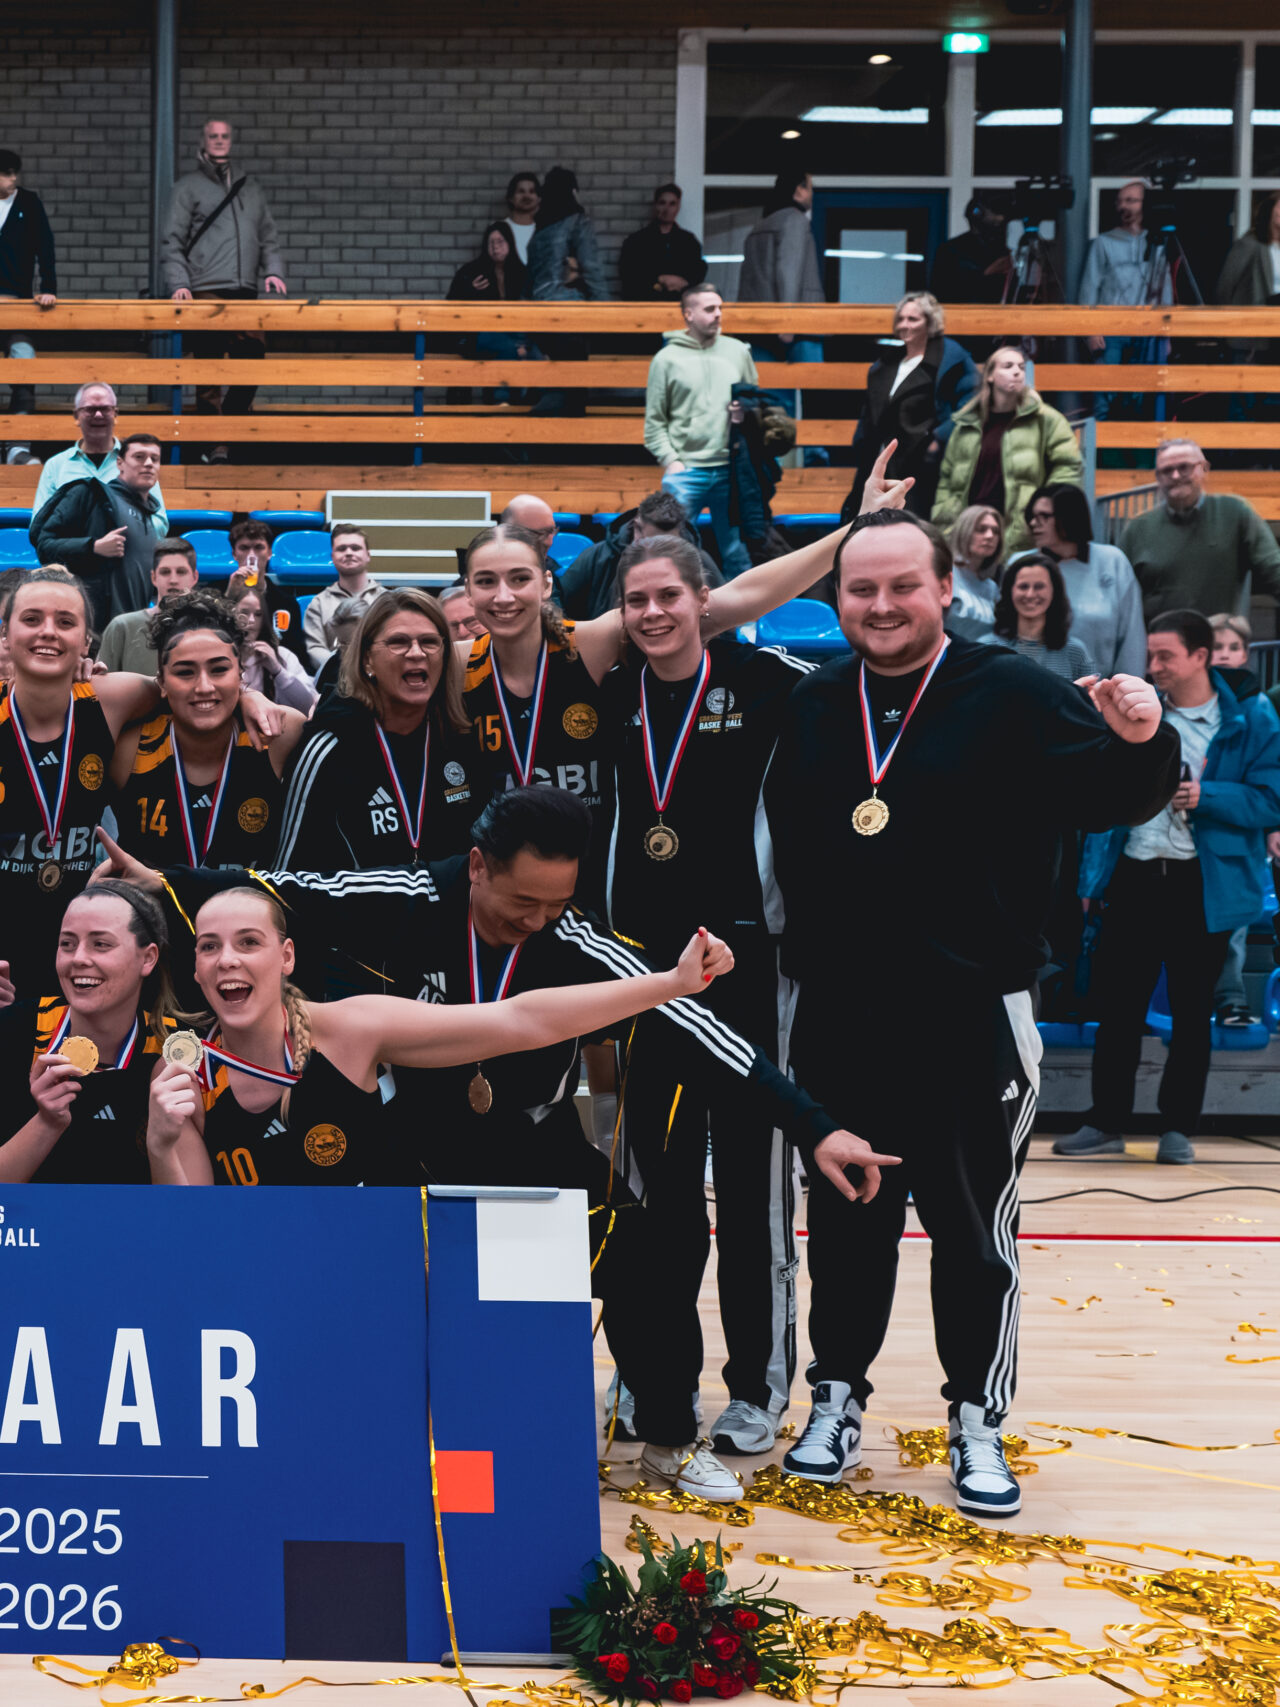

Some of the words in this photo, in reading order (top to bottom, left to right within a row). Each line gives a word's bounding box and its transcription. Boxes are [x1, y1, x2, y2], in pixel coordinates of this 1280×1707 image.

[474, 714, 502, 752] 15
[699, 719, 743, 730] BASKEBALL
[137, 797, 168, 837] 14
[370, 806, 399, 836] RS
[12, 861, 34, 875] DIJK
[215, 1147, 260, 1187] 10
